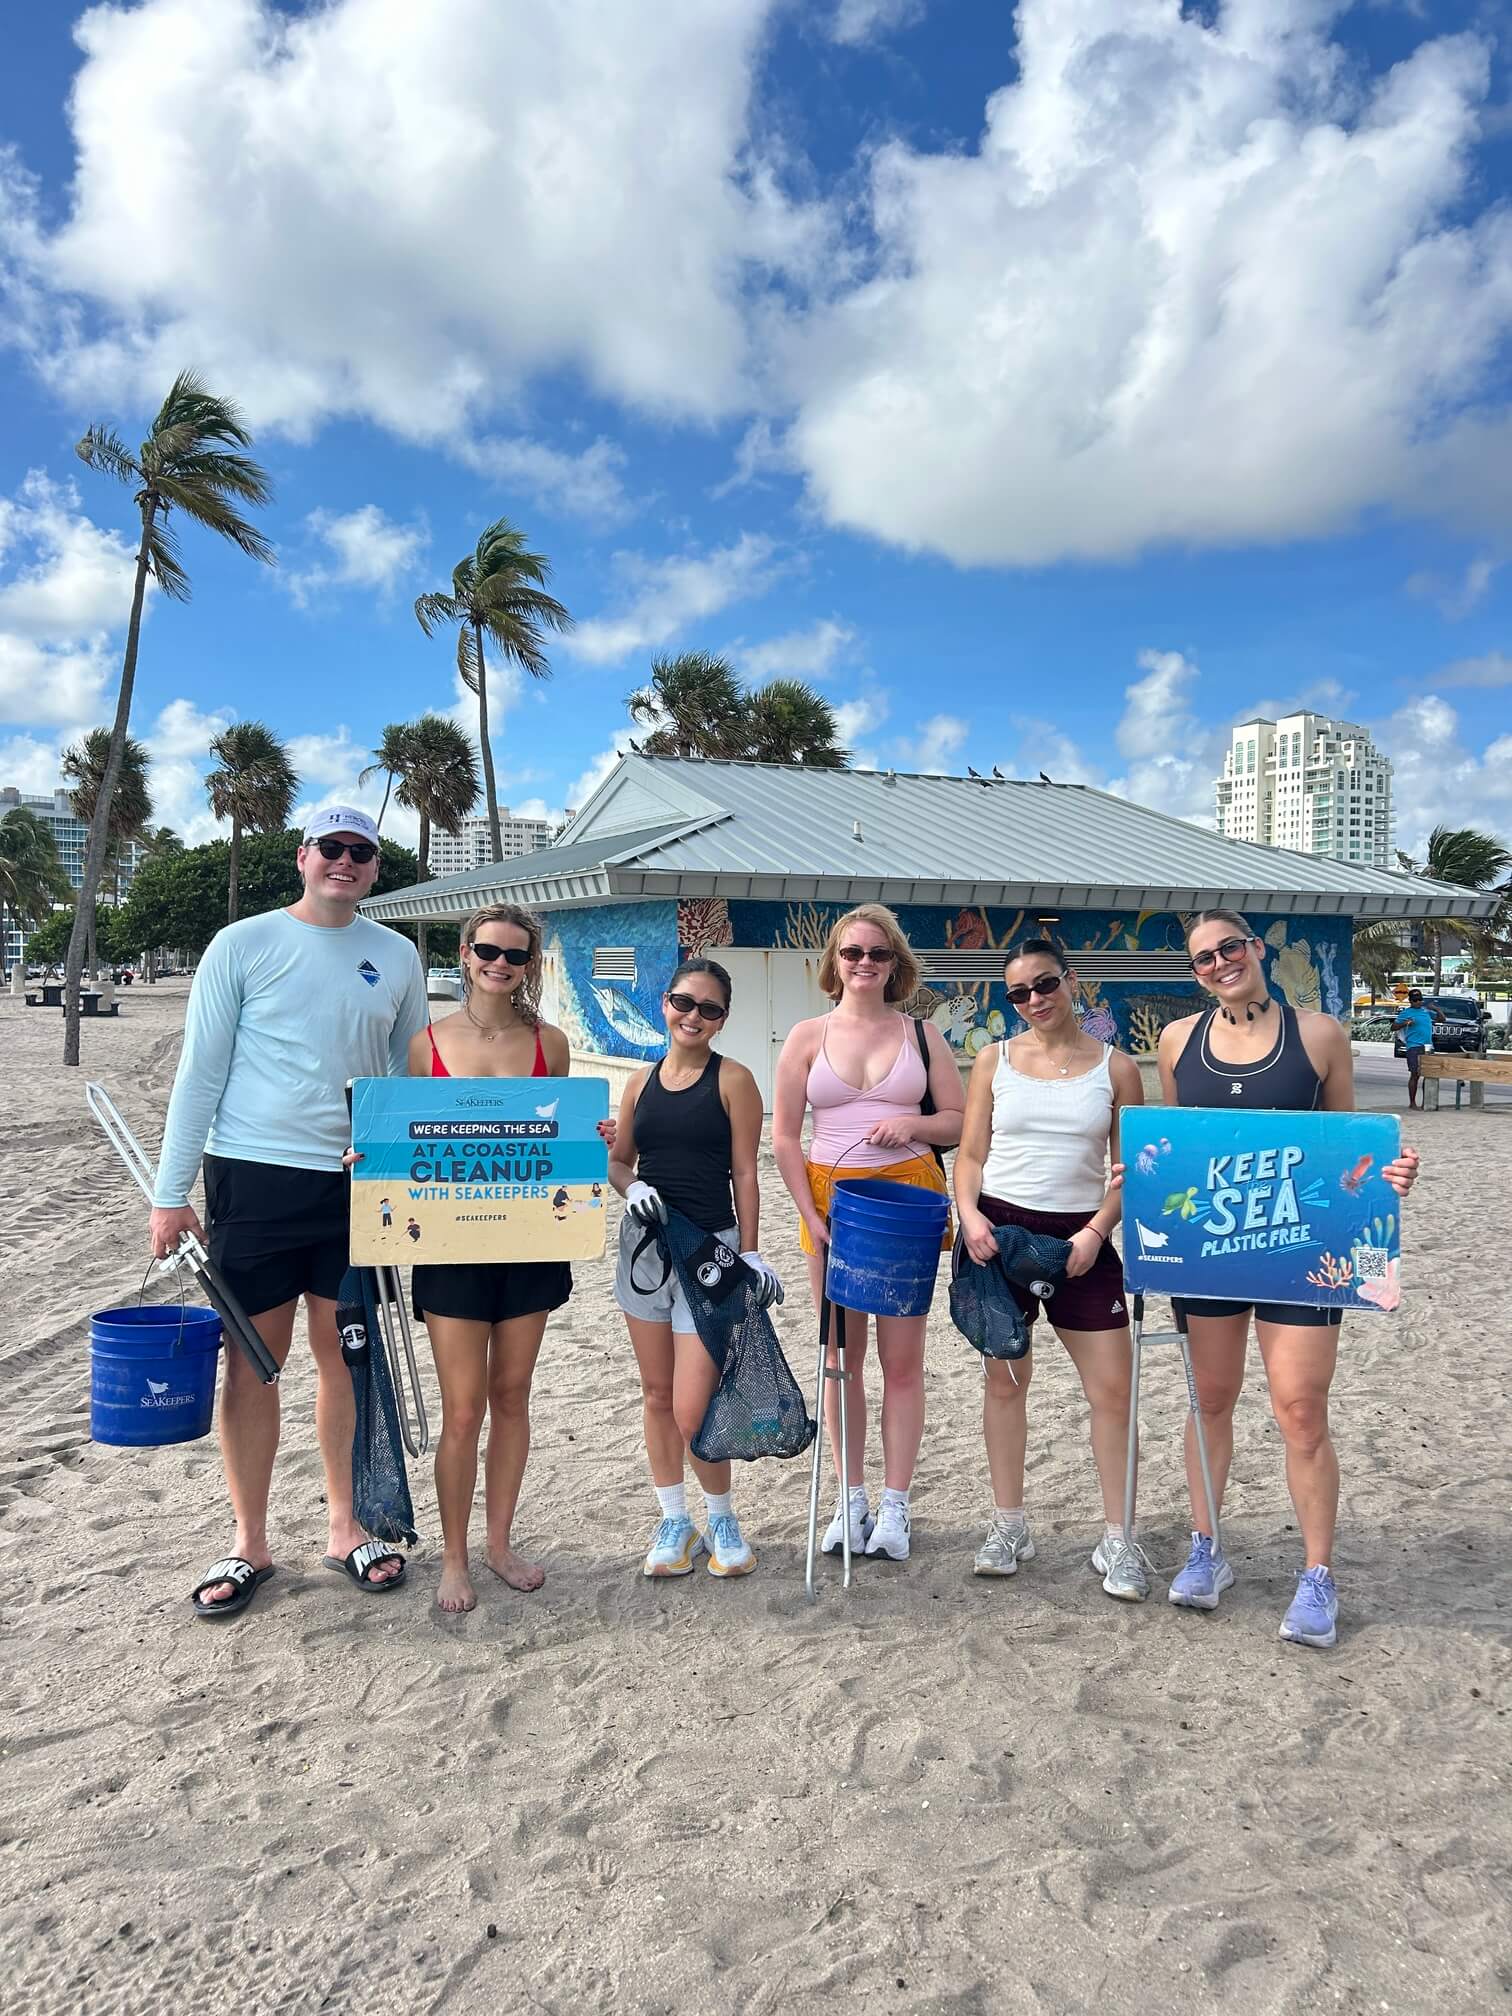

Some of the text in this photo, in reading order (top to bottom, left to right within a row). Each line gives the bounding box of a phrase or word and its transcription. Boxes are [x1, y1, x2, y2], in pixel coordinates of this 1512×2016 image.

[413, 1123, 551, 1135] WE'RE KEEPING THE SEA
[413, 1143, 551, 1158] AT A COASTAL
[410, 1160, 553, 1183] CLEANUP
[1206, 1146, 1304, 1191] KEEP
[408, 1186, 549, 1200] WITH SEAKEEPERS
[1203, 1179, 1300, 1236] SEA
[456, 1214, 507, 1222] #SEAKEEPERS
[1201, 1224, 1311, 1257] PLASTIC FREE
